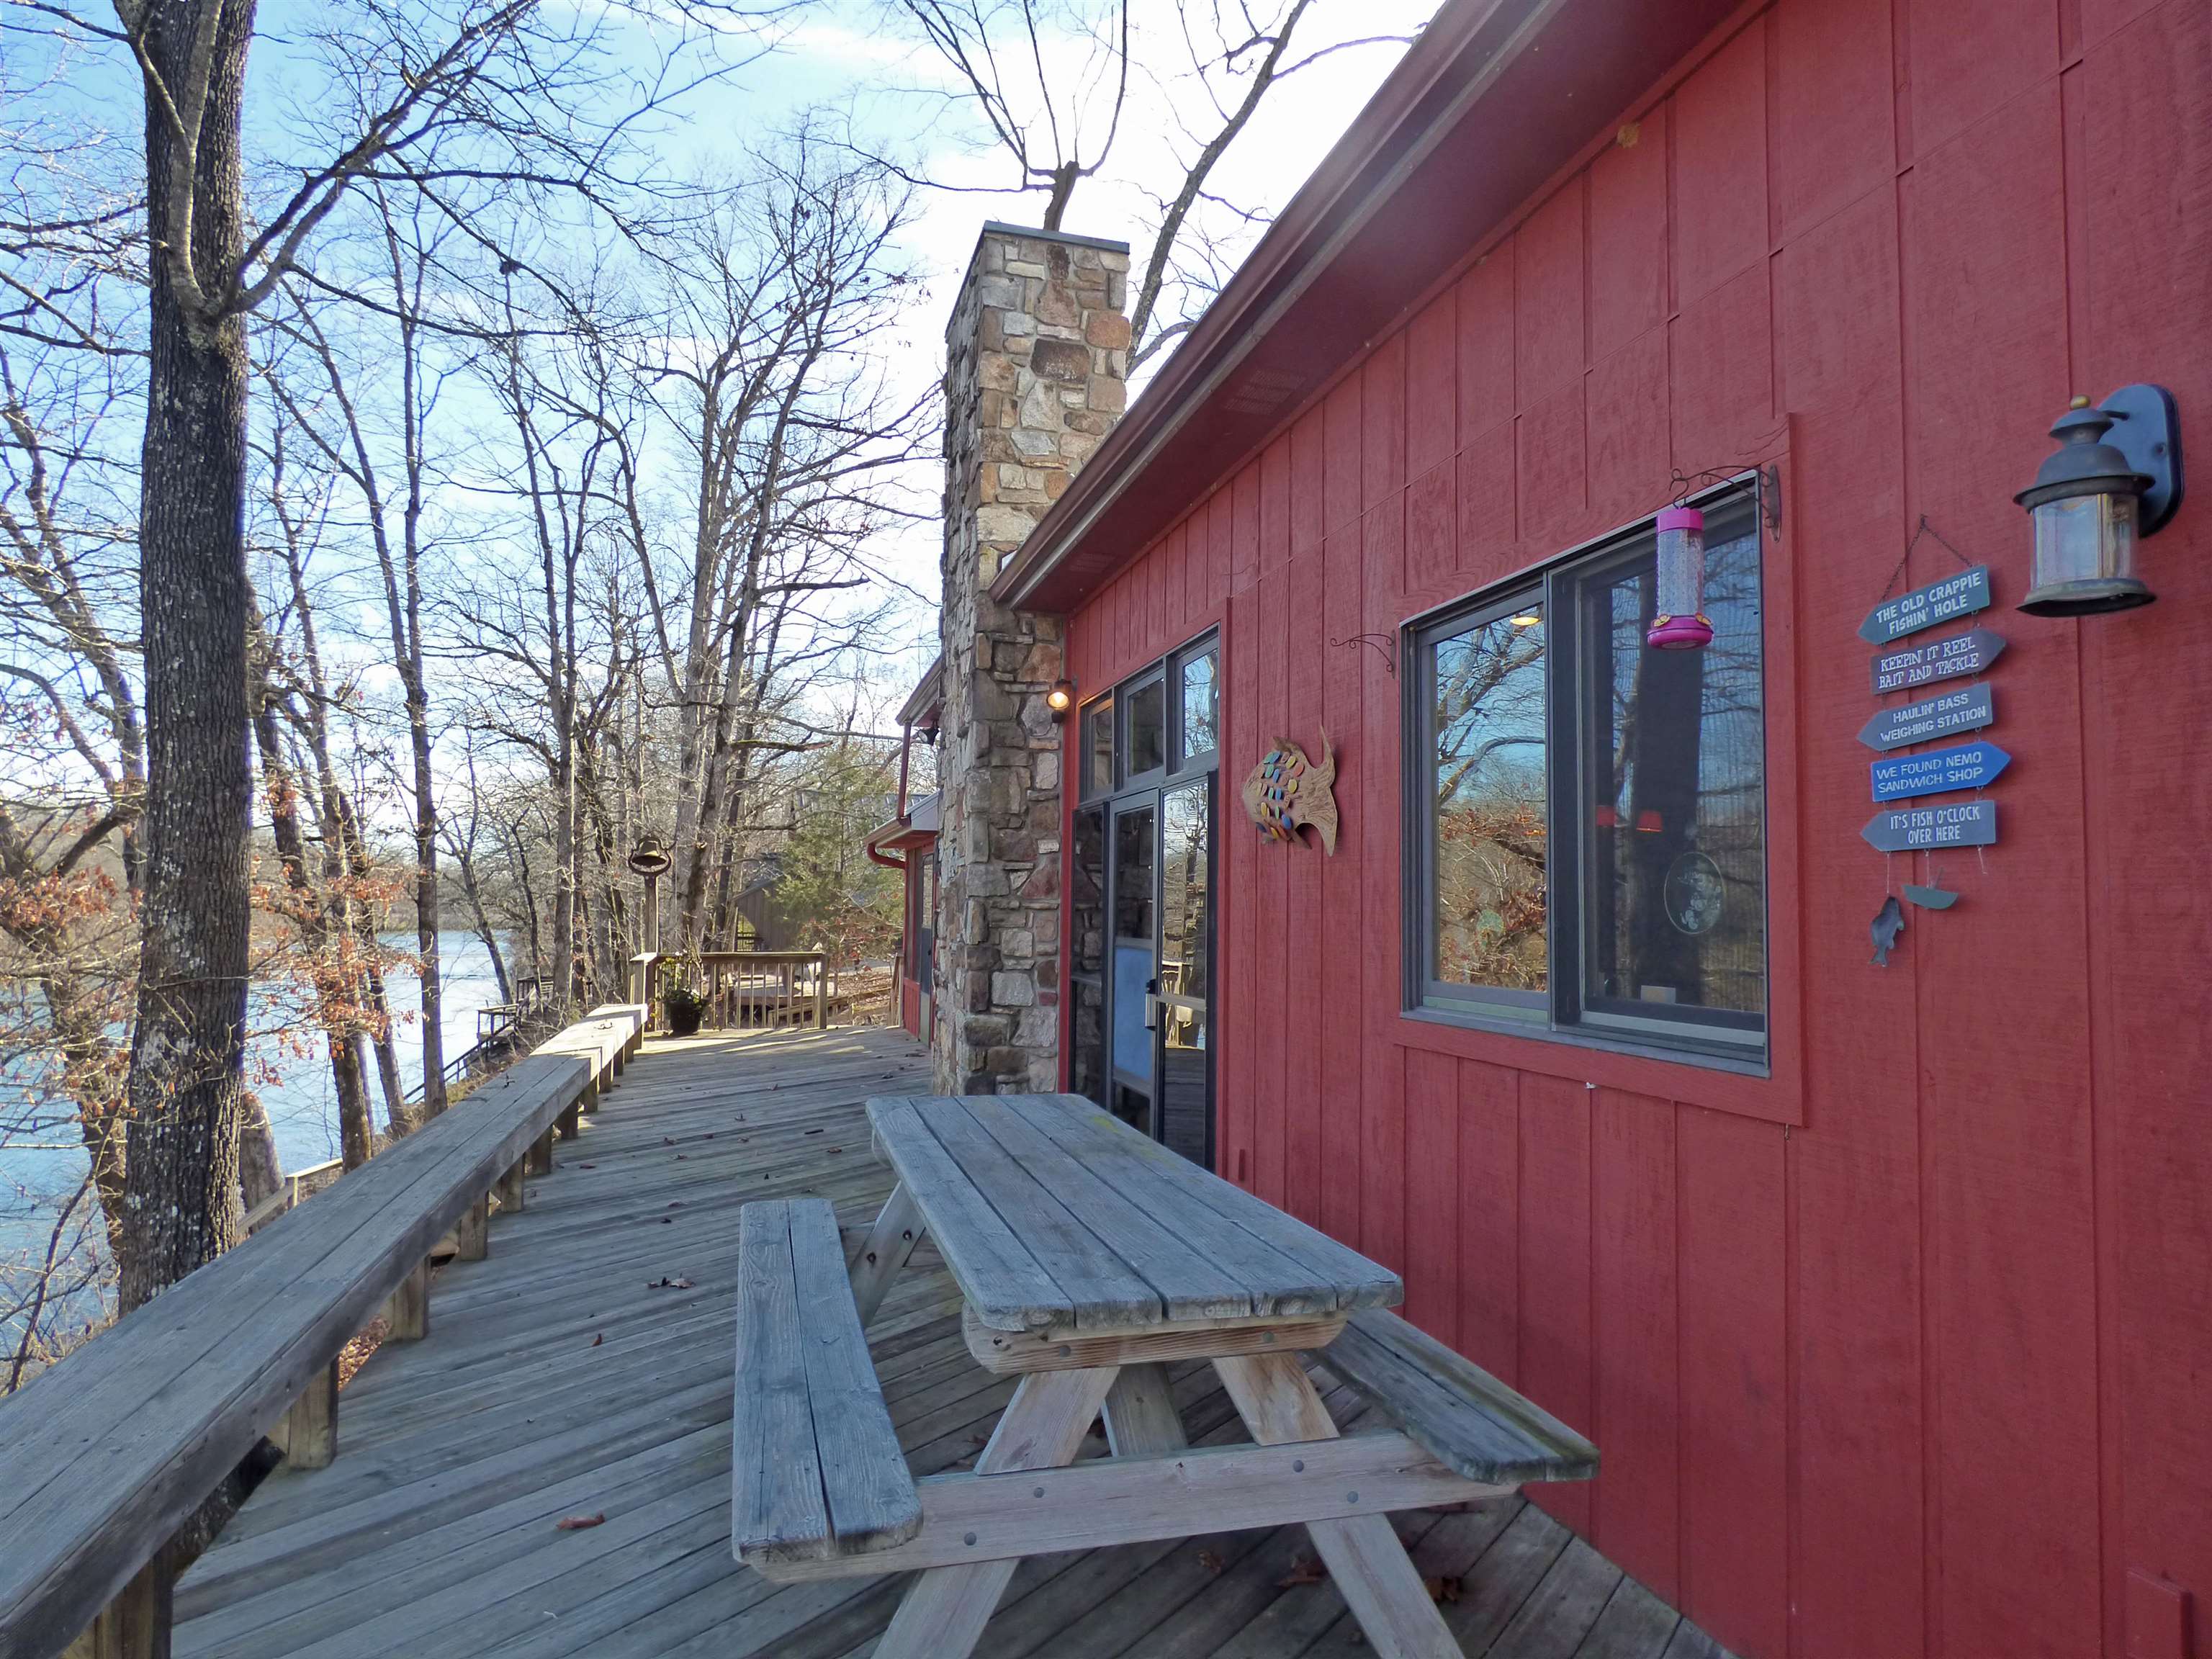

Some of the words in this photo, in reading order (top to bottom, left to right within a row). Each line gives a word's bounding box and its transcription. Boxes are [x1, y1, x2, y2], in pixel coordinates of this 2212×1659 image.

[1876, 605, 1898, 624] THE
[1901, 594, 1925, 613] OLD
[1928, 572, 1982, 602] CRAPPIE
[1934, 594, 1967, 618] HOLE
[1927, 645, 1938, 661] IT
[1943, 637, 1976, 657] REEL
[1879, 671, 1904, 688] BAIT
[1908, 665, 1931, 683] AND
[1936, 653, 1979, 675] TACKLE
[1938, 693, 1969, 711] BASS
[1880, 720, 1934, 742] WEIGHING
[1937, 706, 1986, 728] STATION
[1876, 766, 1898, 779] WE
[1901, 759, 1941, 775] FOUND
[1946, 752, 1982, 767] NEMO
[1878, 773, 1943, 793] SANDWICH
[1947, 768, 1983, 782] SHOP
[1912, 811, 1933, 827] FISH
[1908, 828, 1931, 845] OVER
[1936, 825, 1961, 841] HERE
